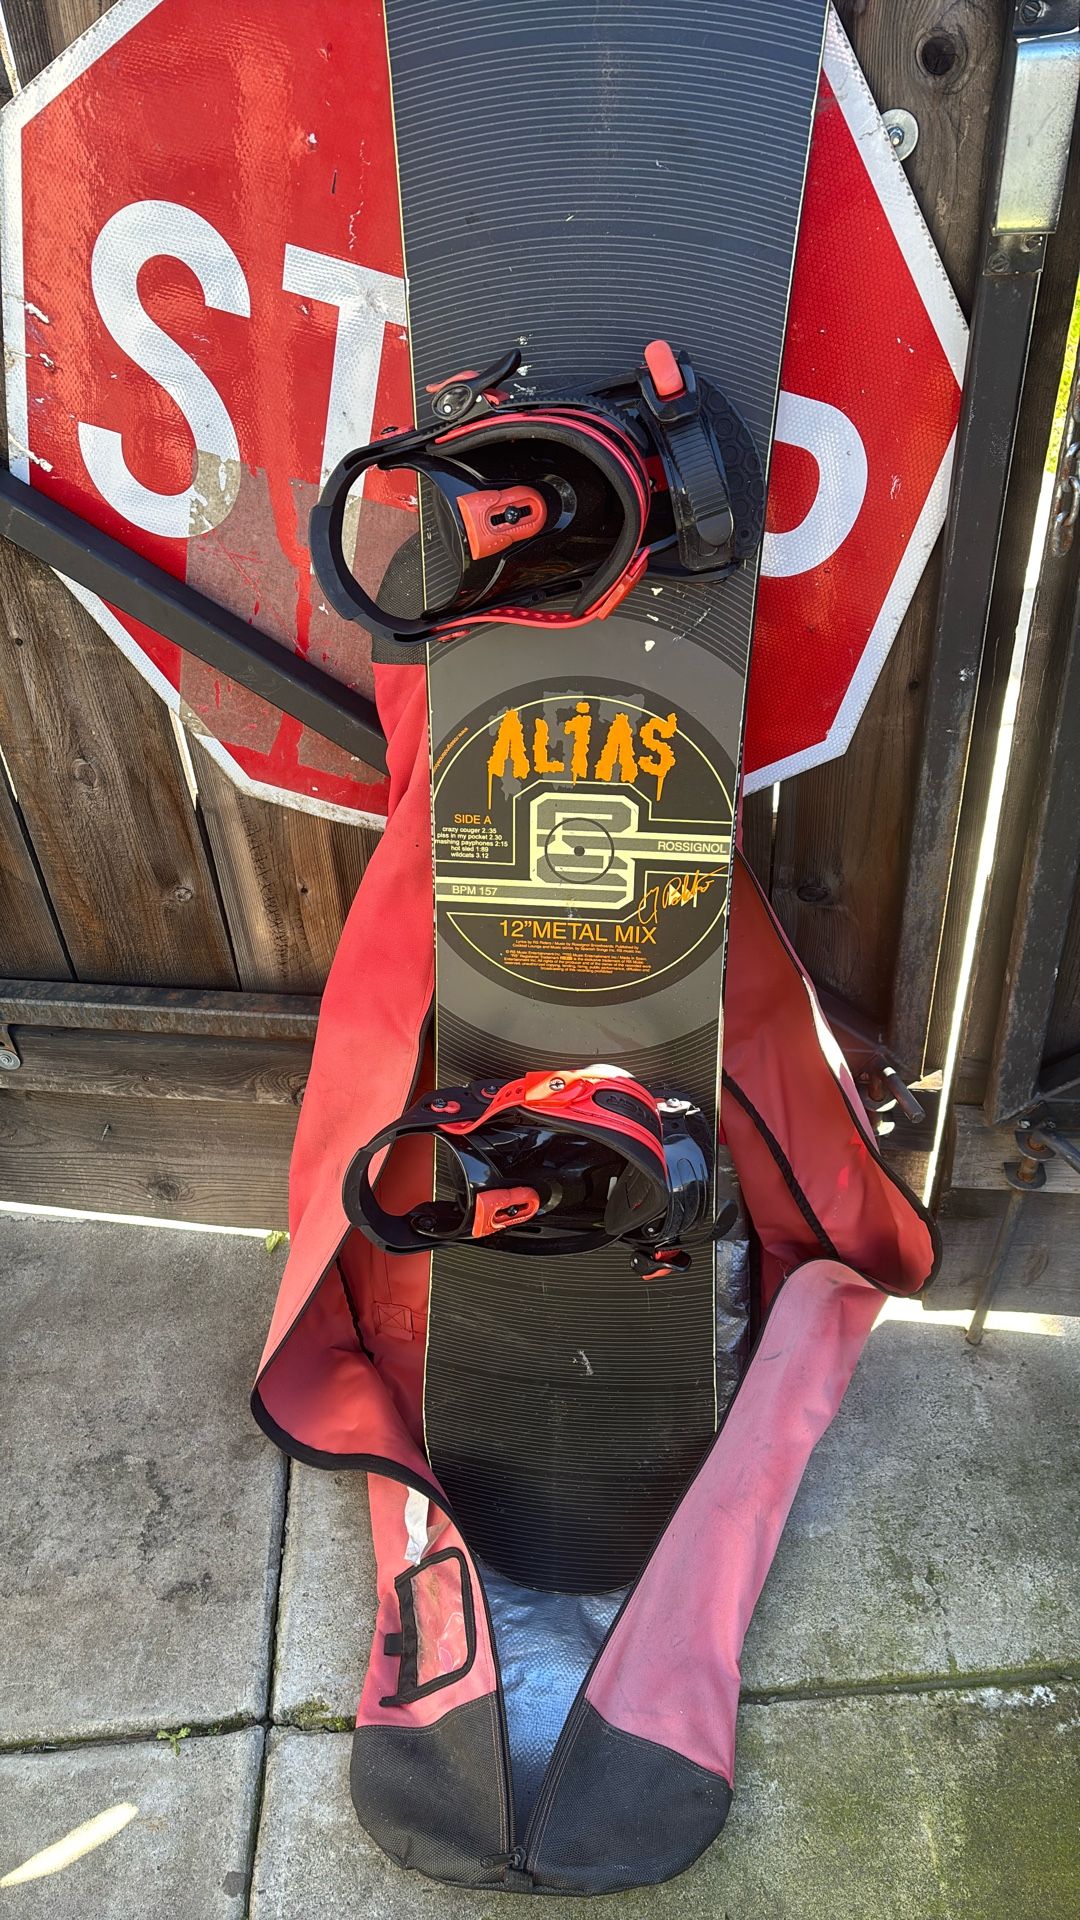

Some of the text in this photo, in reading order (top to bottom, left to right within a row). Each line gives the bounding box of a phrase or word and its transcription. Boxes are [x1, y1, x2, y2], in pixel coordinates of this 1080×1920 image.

[454, 814, 492, 825] SIDE A
[657, 841, 727, 853] ROSSIGNOL
[452, 885, 497, 896] BPM 157
[615, 924, 657, 944] MIX
